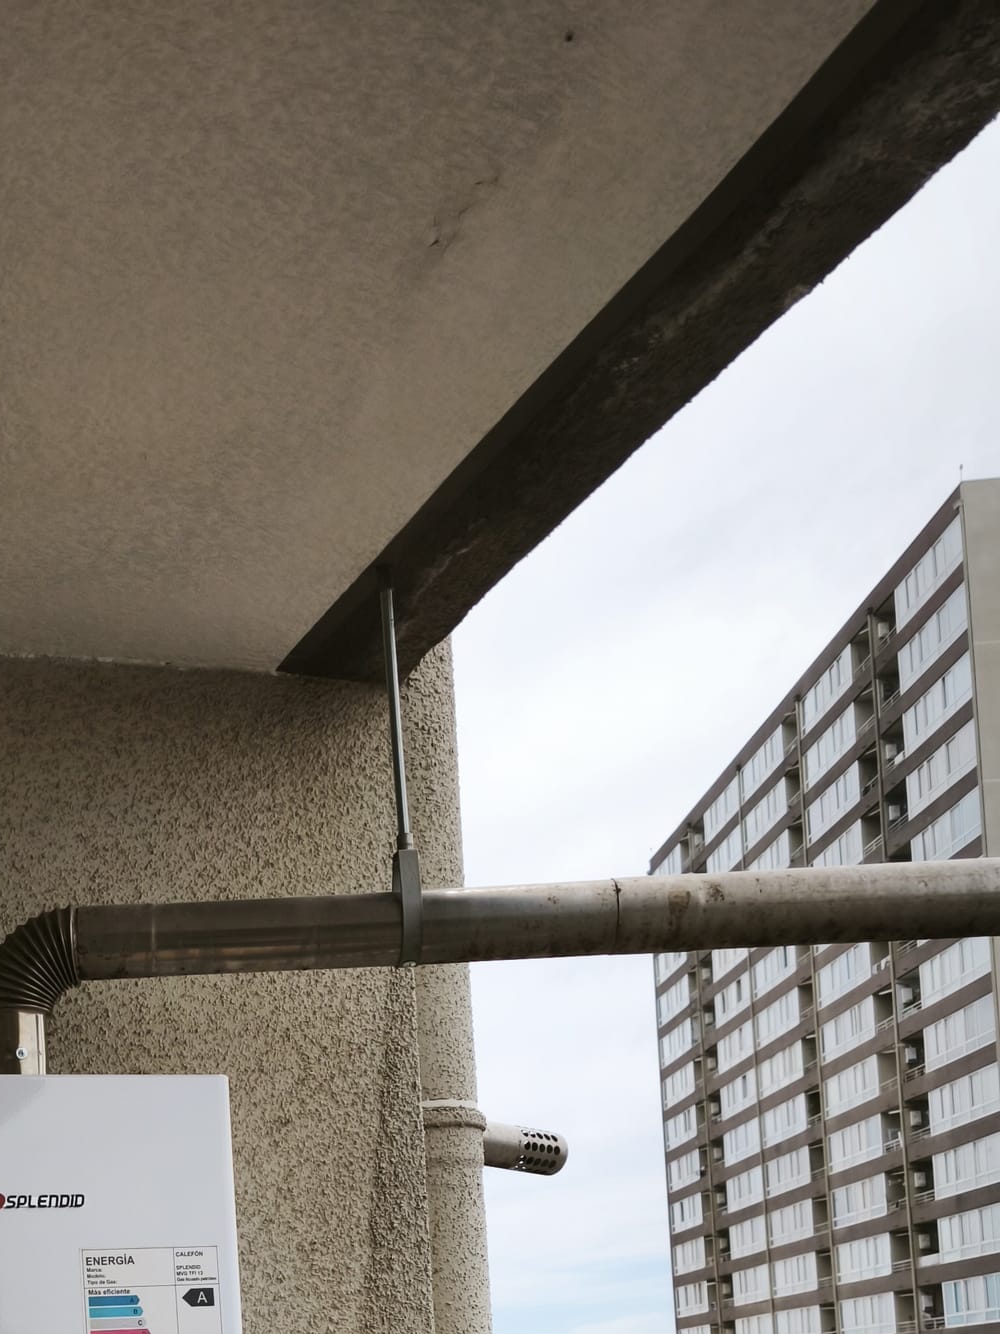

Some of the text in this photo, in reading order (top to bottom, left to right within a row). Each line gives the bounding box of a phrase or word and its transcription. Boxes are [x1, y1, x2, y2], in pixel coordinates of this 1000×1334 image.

[4, 1194, 85, 1209] SPLENDID
[85, 1253, 135, 1266] ENERGÍA
[197, 1290, 208, 1304] A
